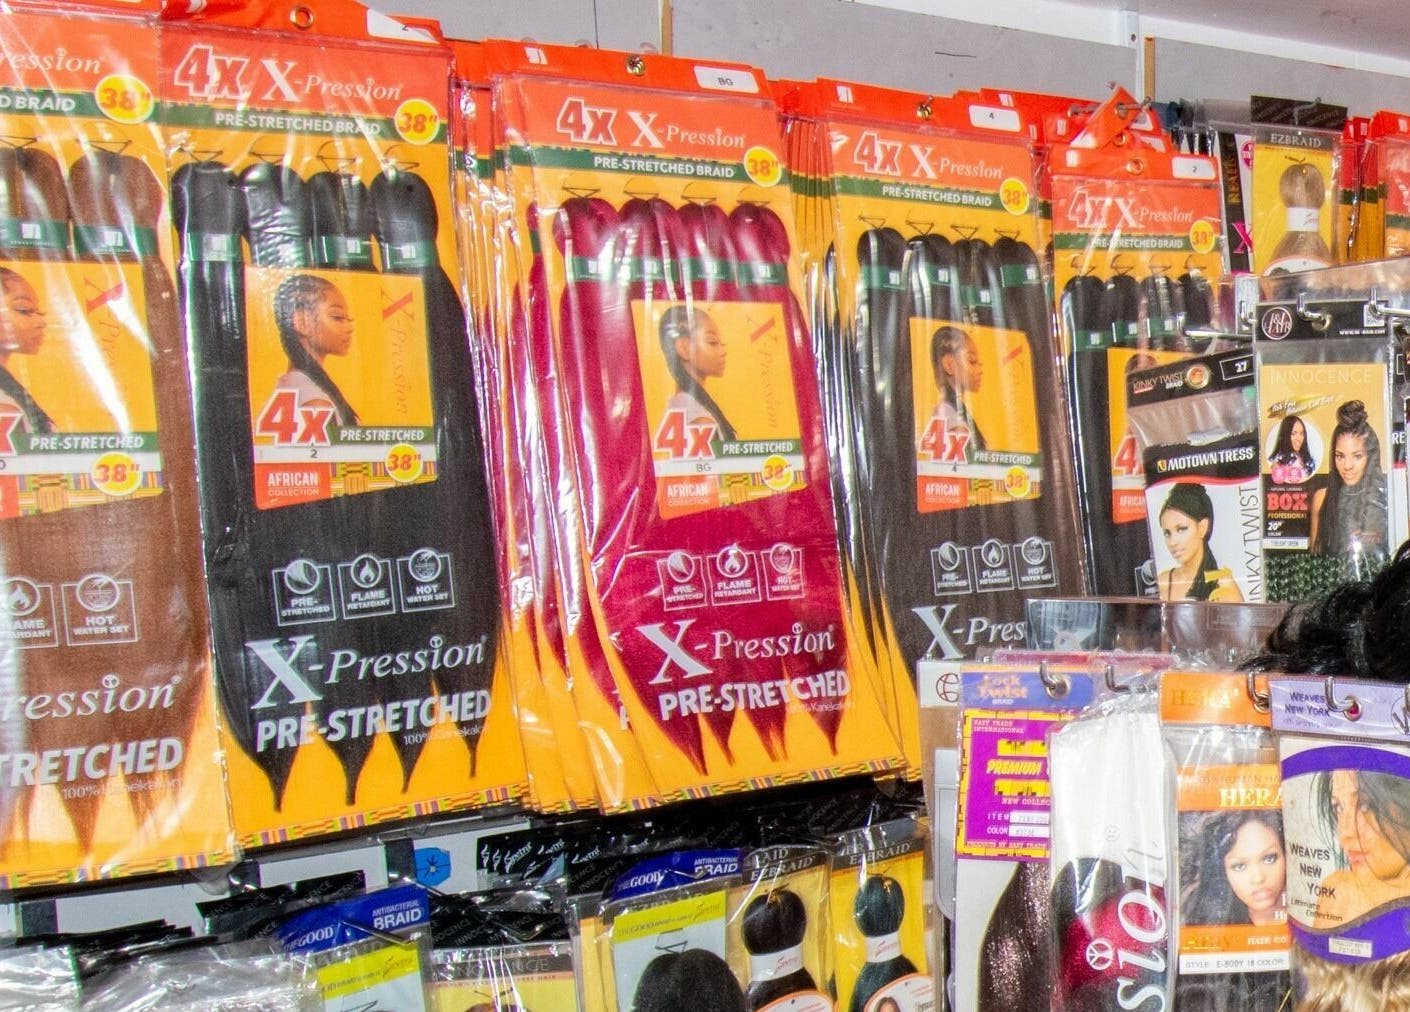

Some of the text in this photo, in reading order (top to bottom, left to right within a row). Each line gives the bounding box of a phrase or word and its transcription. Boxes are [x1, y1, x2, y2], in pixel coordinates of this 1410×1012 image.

[717, 77, 735, 87] BG
[25, 96, 77, 112] BRAID
[215, 113, 333, 135] PRE-STRETCHED
[398, 112, 440, 135] 38"
[627, 109, 746, 150] X-Pression
[1270, 132, 1322, 149] EZBRAID
[594, 156, 735, 179] PRE-STRETCHED BRAID
[881, 185, 993, 207] PRE-STRETCHED BRAID
[1155, 240, 1184, 250] BRAID
[1235, 360, 1248, 373] 27
[1133, 372, 1184, 393] KINKY TWIST
[1269, 368, 1373, 385] INNOCENCE
[29, 434, 145, 452] PRE-STRETCHED
[339, 426, 426, 443] PRE-STRETCHED
[722, 441, 794, 456] PRE-STRETCHED
[386, 453, 422, 472] 38"
[973, 451, 1033, 466] PRE-STRETCHED
[1167, 447, 1254, 472] MOTOWN TRESS
[94, 462, 140, 484] 38"
[695, 462, 712, 473] BG
[267, 471, 319, 487] AFRICAN
[667, 482, 710, 499] AFRICAN
[925, 483, 960, 497] AFRICAN
[1267, 492, 1309, 511] BOX
[1238, 486, 1260, 548] TWIST
[415, 585, 438, 596] HOT
[717, 580, 752, 591] FLAME
[291, 597, 319, 608] PRE-
[350, 589, 387, 602] FLAME
[282, 606, 330, 617] STRETCHED
[85, 615, 115, 627] HOT
[635, 618, 836, 686] X-Pression
[245, 634, 488, 710] X-Pression
[659, 669, 852, 722] PRE-STRETCHED
[1289, 692, 1326, 704] WEAVES
[1284, 705, 1331, 717] NEW YORK
[257, 688, 493, 753] PRE-STRETCHED
[986, 759, 1043, 776] PREMIUM
[987, 812, 1010, 821] ITEM
[986, 826, 1009, 836] COLOR
[849, 842, 911, 865] EZBRAID
[1290, 845, 1331, 862] WEAVES
[751, 855, 816, 883] EZBRAID
[1299, 862, 1322, 878] NEW
[1306, 882, 1336, 899] YORK
[372, 900, 420, 918] ANTIBACTERIAL
[373, 908, 422, 931] BRAID
